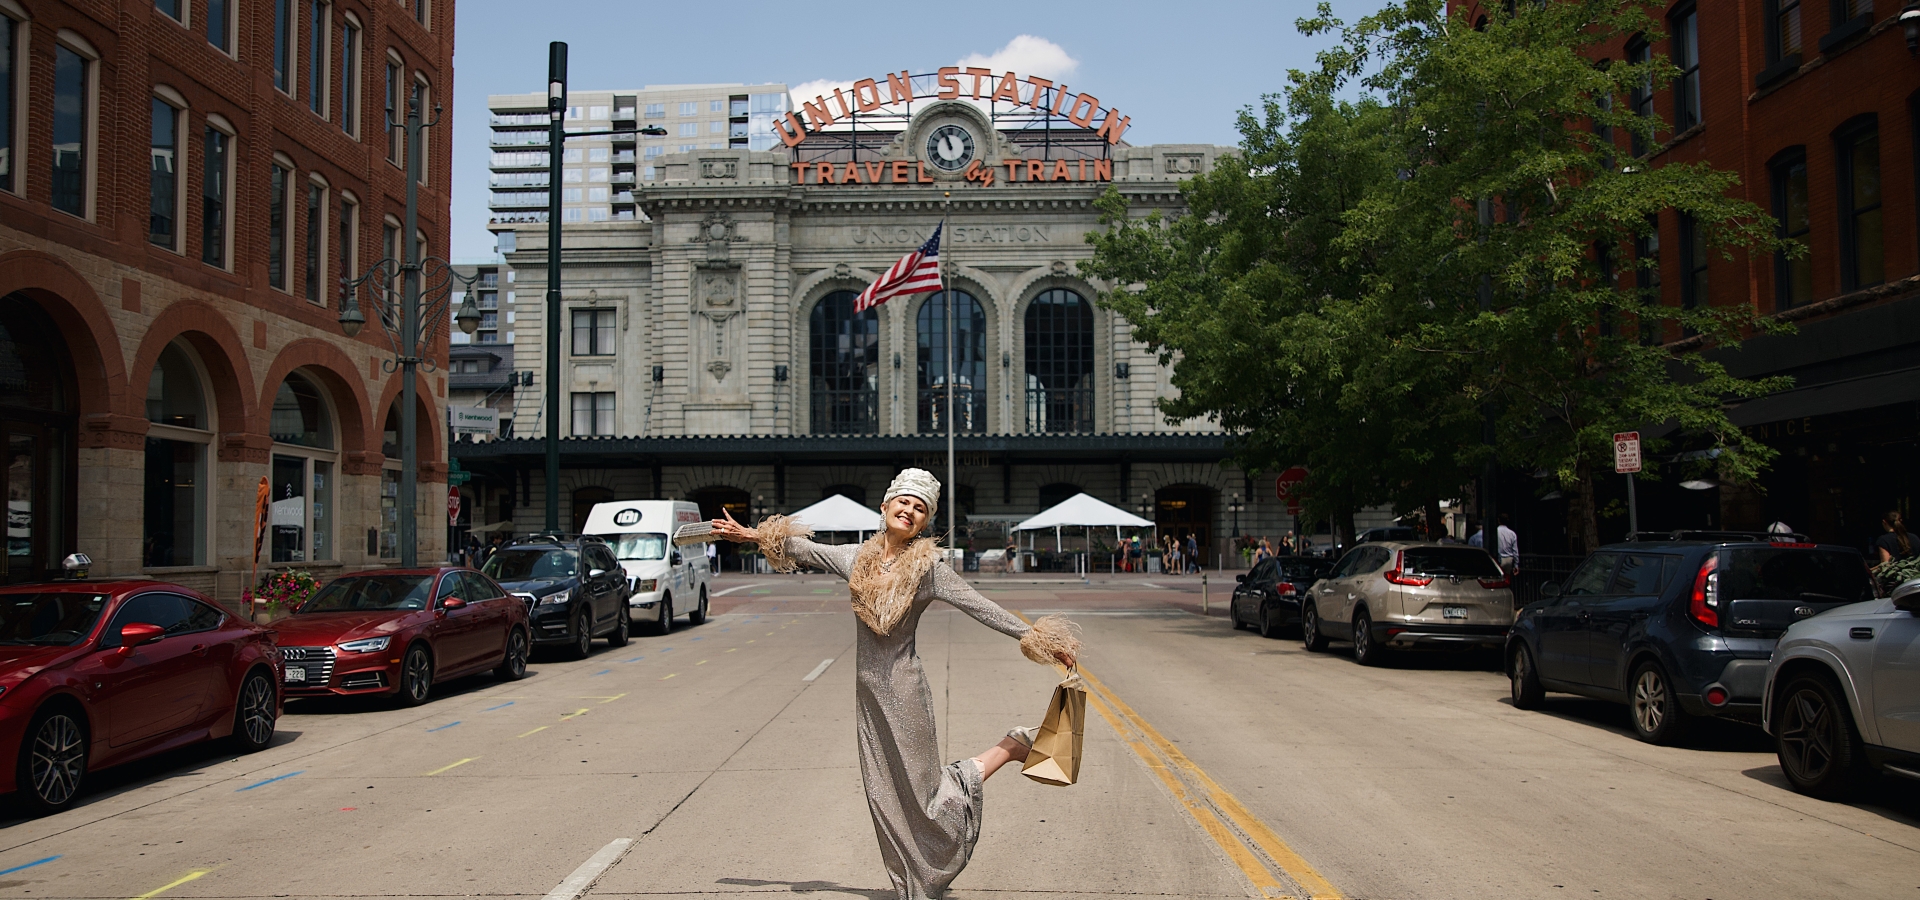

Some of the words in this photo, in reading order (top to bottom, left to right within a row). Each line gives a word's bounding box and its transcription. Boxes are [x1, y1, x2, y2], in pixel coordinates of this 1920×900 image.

[773, 70, 913, 147] UNION
[938, 67, 1131, 145] STATION
[791, 160, 934, 185] TRAVEL
[964, 159, 994, 188] by
[1004, 158, 1112, 182] TRAIN
[851, 227, 929, 244] UNION
[953, 227, 1050, 243] STATION
[1746, 417, 1811, 439] ENICE
[448, 496, 460, 509] STOP
